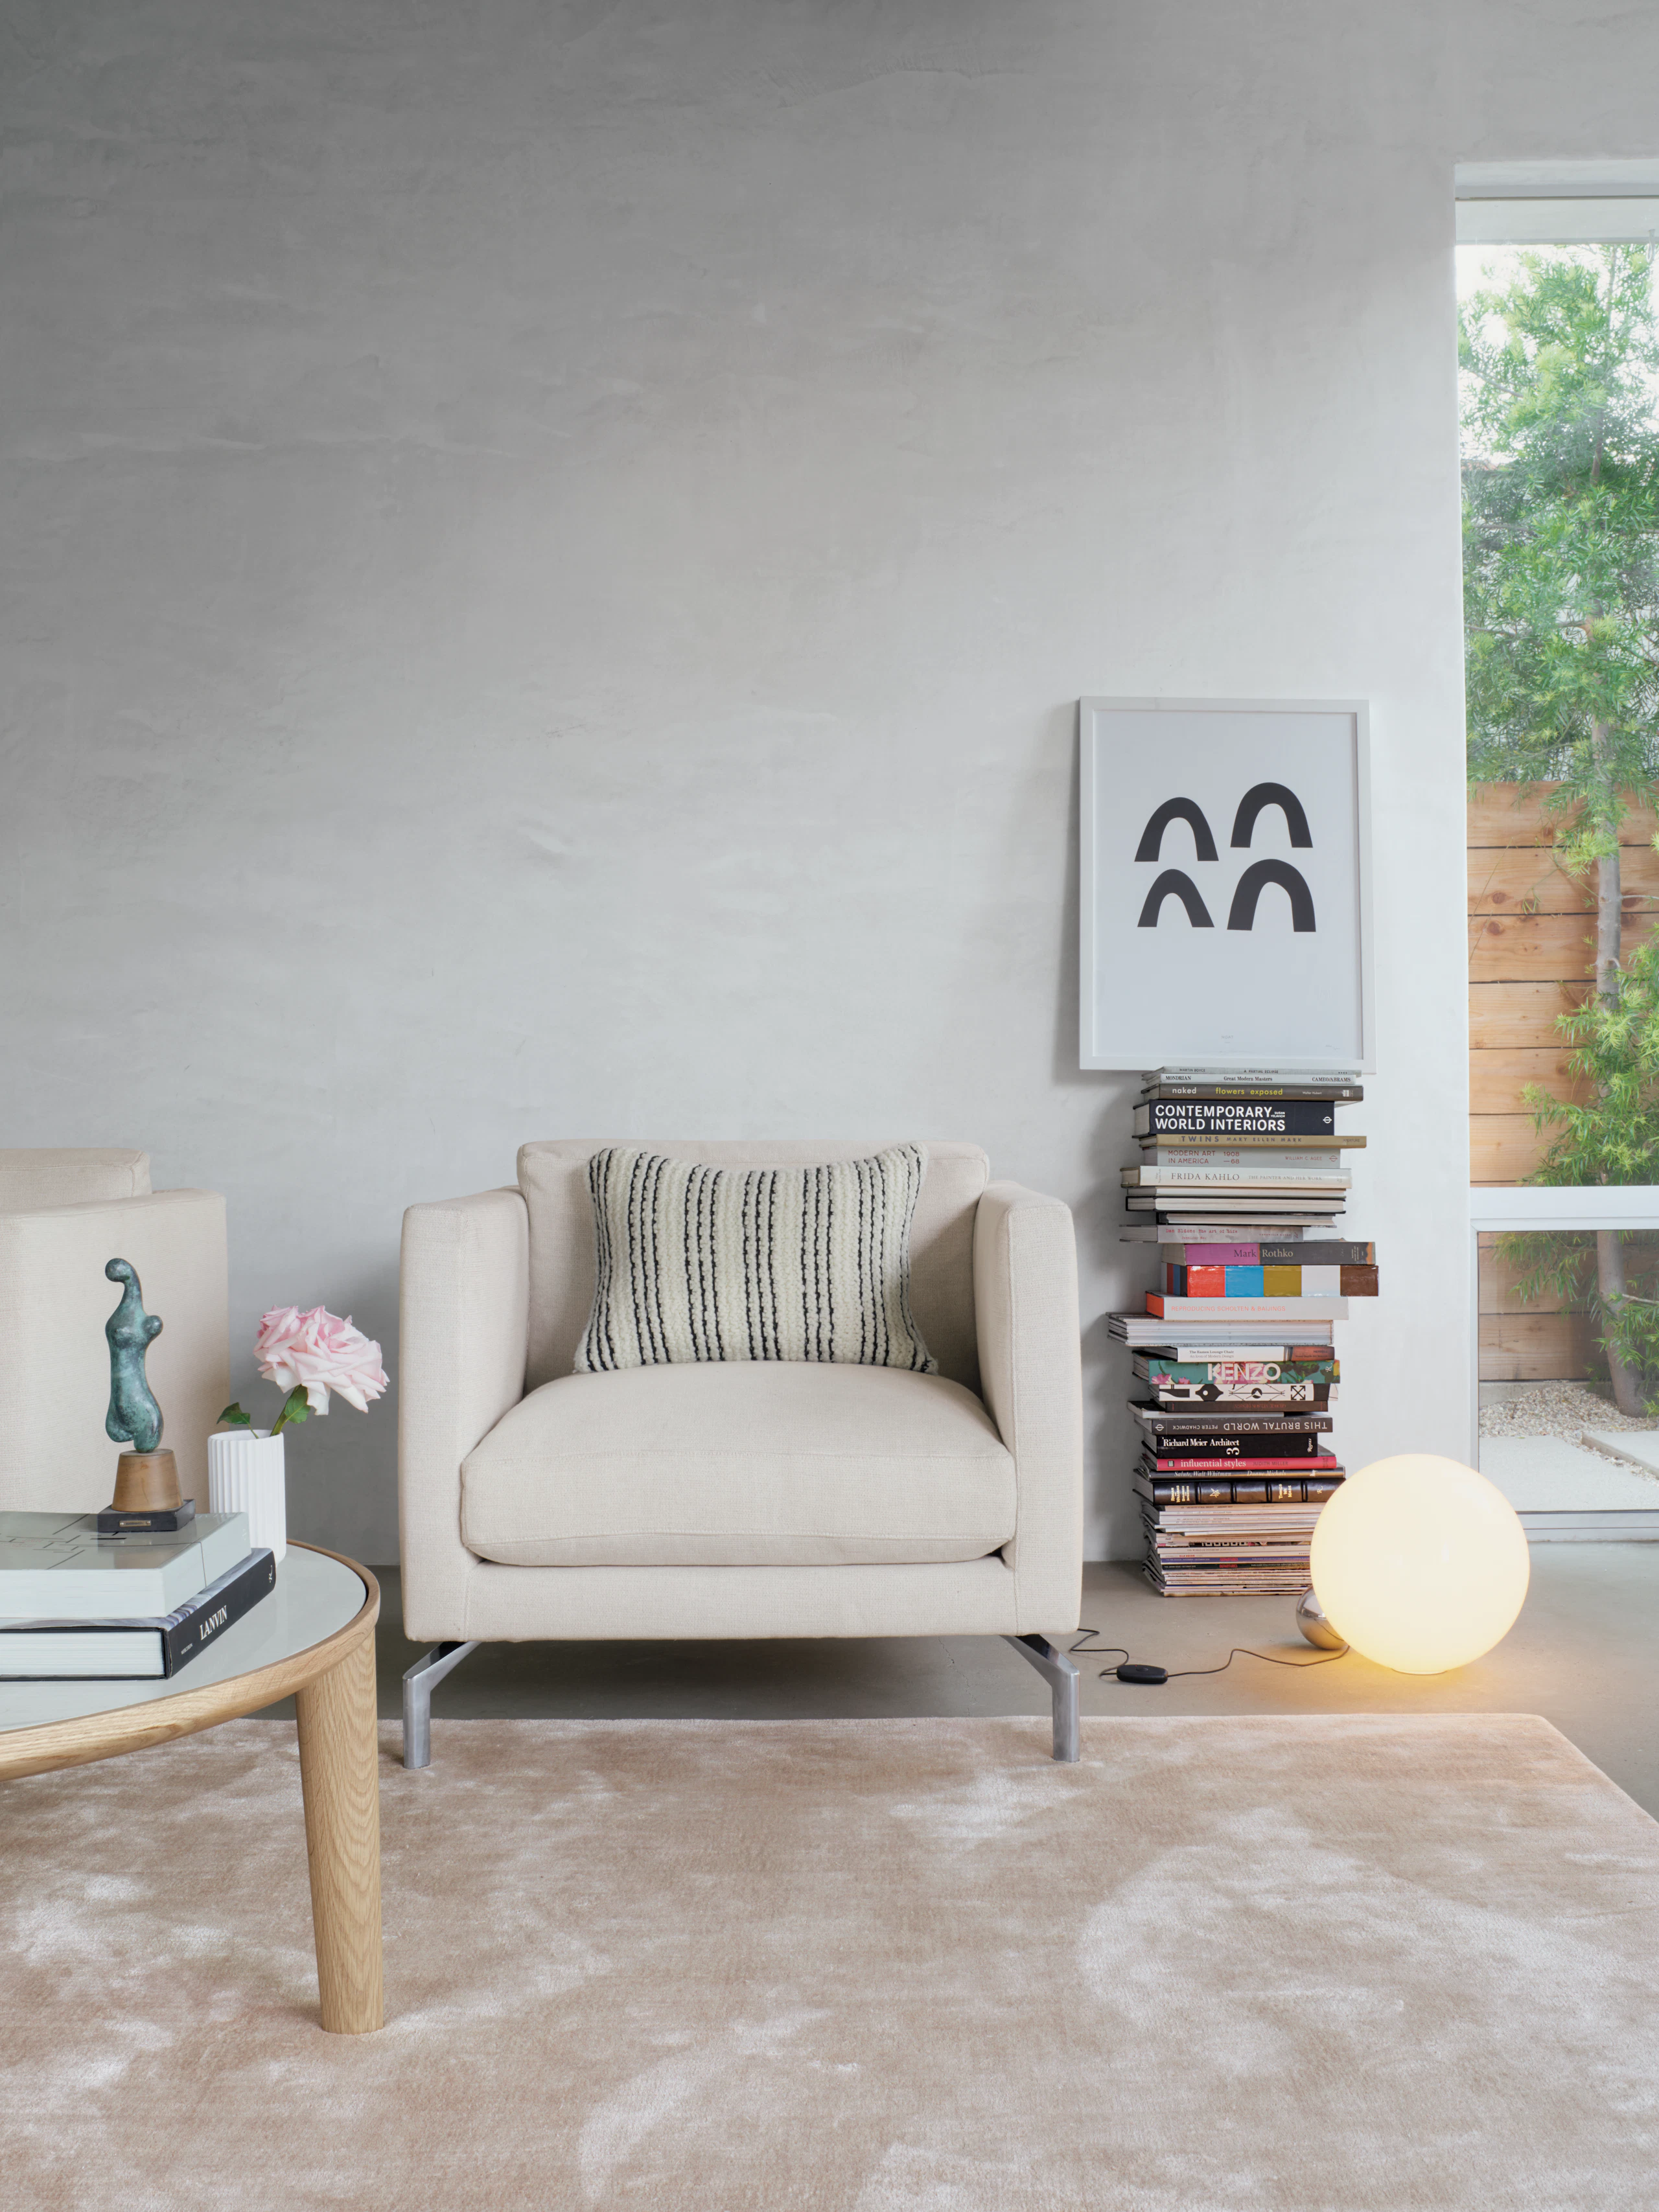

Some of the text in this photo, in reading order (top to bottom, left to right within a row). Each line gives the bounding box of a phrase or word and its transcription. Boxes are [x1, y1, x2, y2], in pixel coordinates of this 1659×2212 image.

[1249, 1088, 1283, 1096] exposed
[1155, 1104, 1273, 1118] CONTEMPORARY
[1155, 1118, 1286, 1131] WORLD INTERIORS
[1233, 1249, 1257, 1258] Mark
[1262, 1249, 1294, 1258] Rothko
[1207, 1363, 1281, 1381] KENZO
[1163, 1438, 1189, 1447] Richard
[1181, 1458, 1222, 1468] influential
[1224, 1458, 1246, 1468] styles
[199, 1605, 227, 1641] LANVIN
